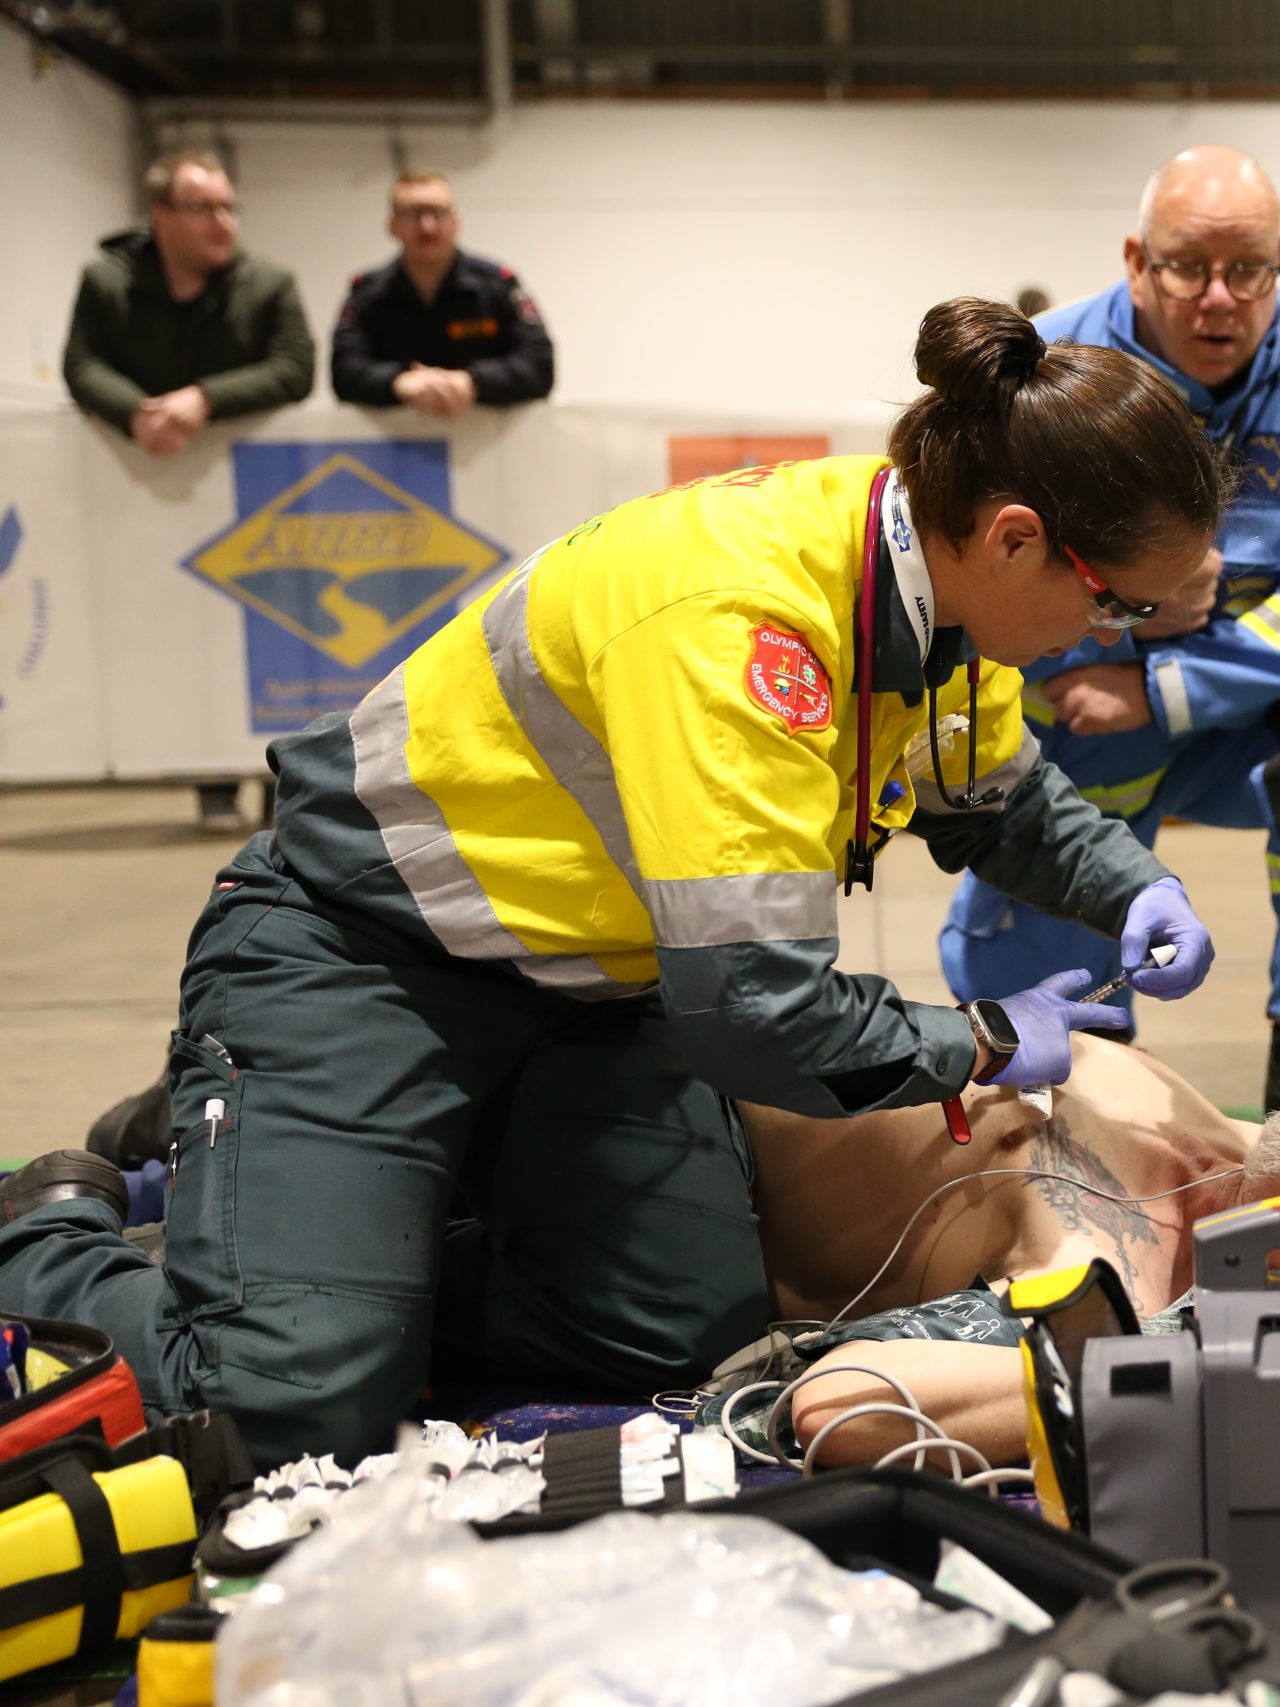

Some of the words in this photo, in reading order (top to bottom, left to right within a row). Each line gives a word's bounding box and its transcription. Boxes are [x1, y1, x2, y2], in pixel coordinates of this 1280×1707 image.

[915, 596, 929, 629] SAFETY
[760, 631, 807, 657] OLYMPIC
[751, 663, 799, 720] EMERGENCY
[801, 692, 829, 723] SERVICES
